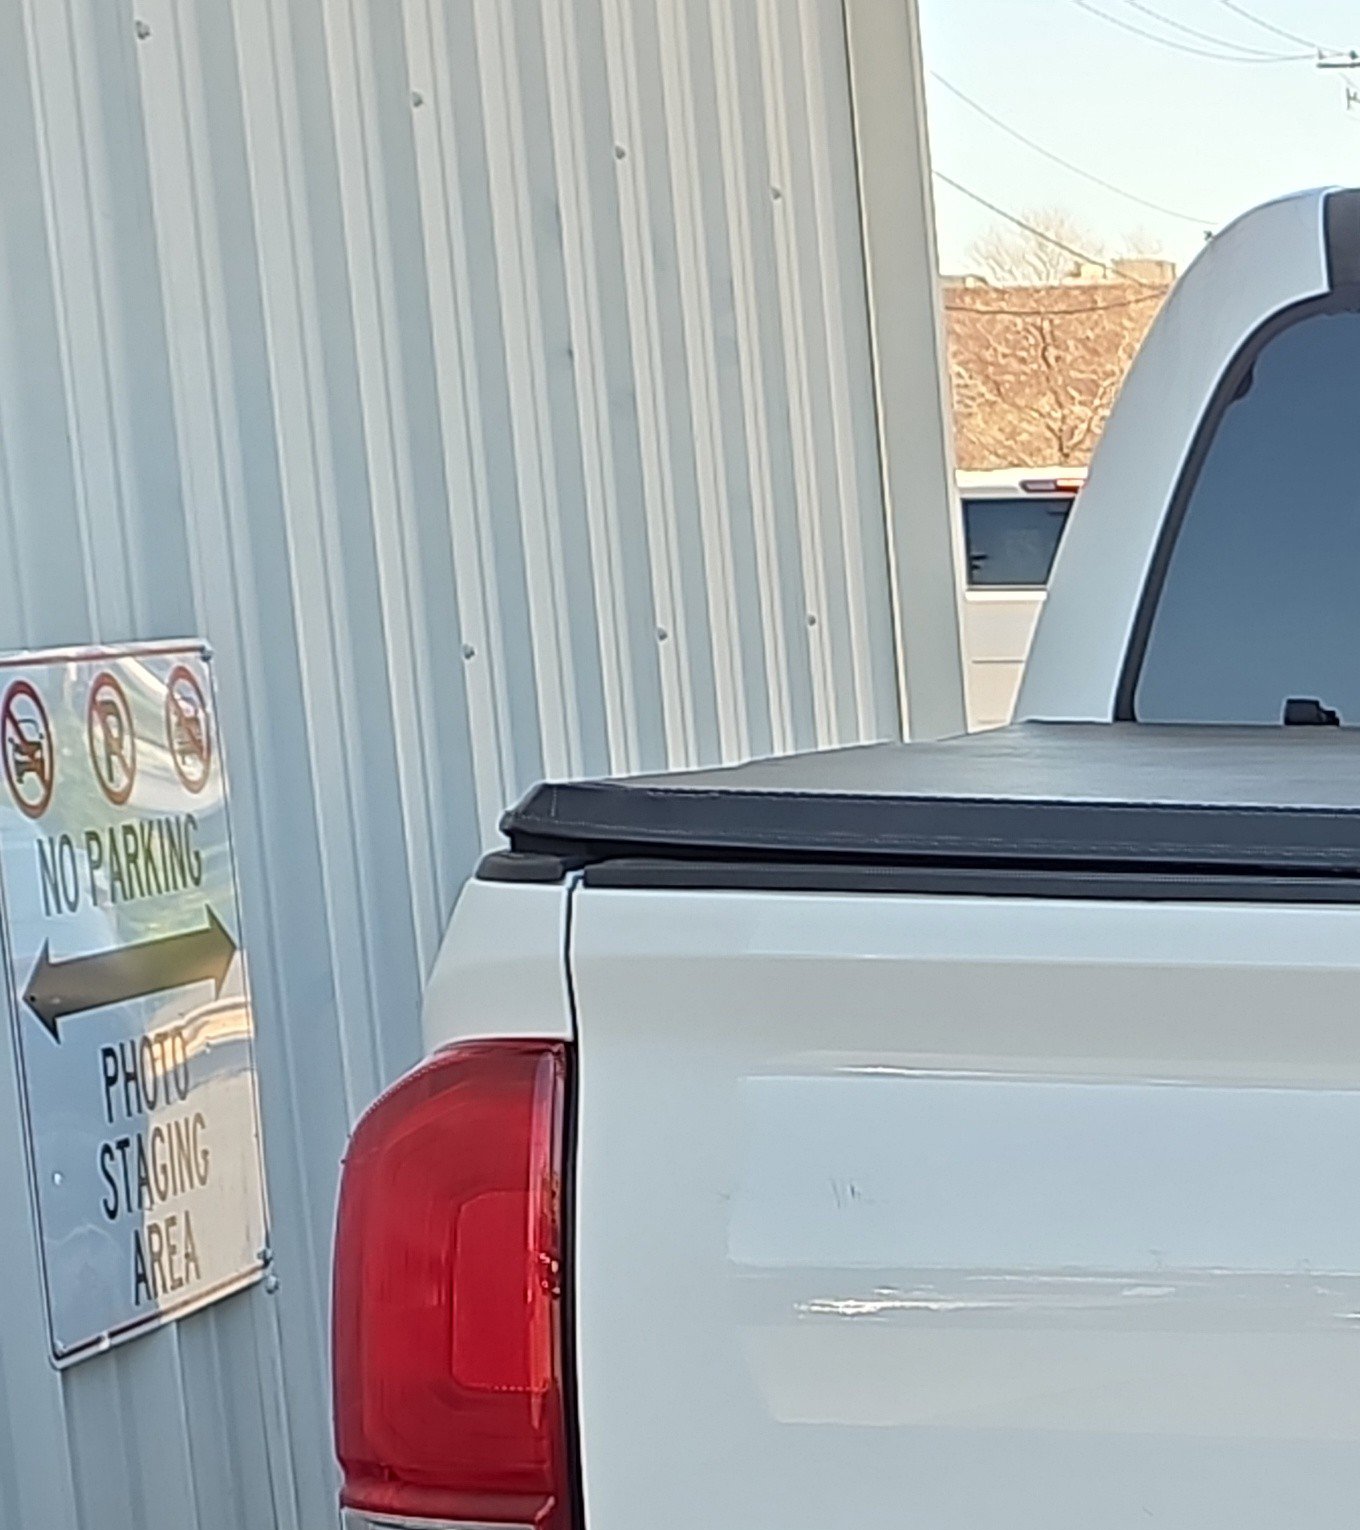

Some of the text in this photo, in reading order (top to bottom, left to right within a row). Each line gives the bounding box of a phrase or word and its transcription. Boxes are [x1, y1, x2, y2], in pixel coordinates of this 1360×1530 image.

[36, 812, 202, 917] NO PARKING
[101, 1029, 189, 1124] PHOTO
[100, 1111, 209, 1221] STAGING
[132, 1210, 202, 1307] AREA
